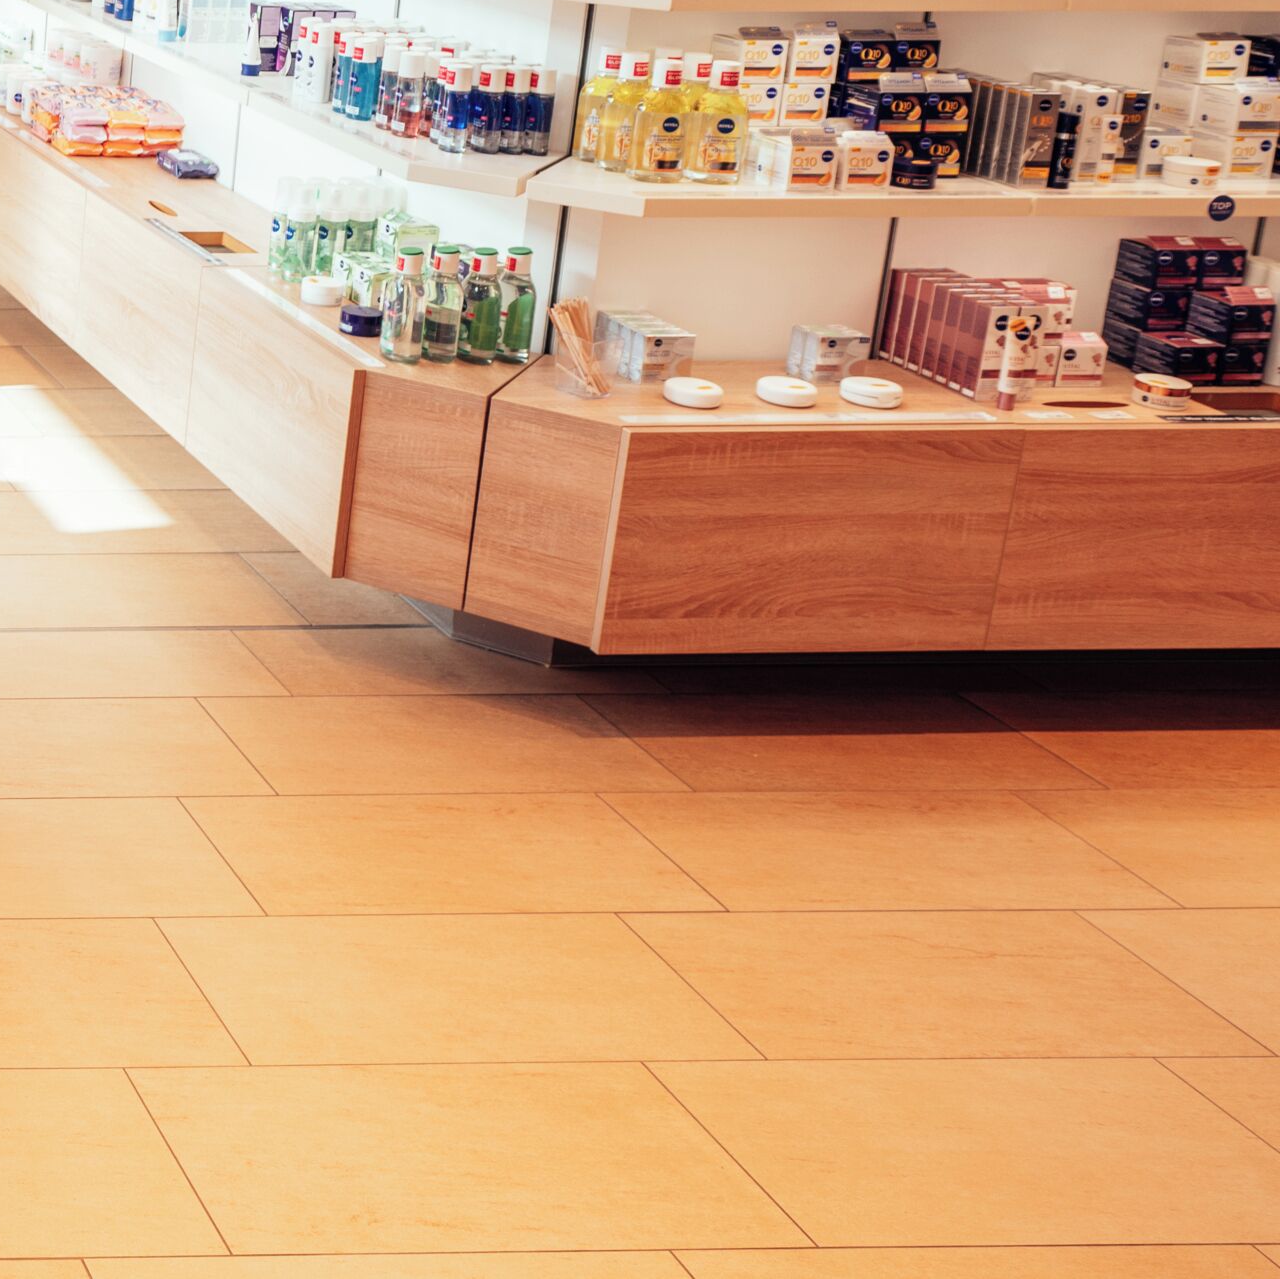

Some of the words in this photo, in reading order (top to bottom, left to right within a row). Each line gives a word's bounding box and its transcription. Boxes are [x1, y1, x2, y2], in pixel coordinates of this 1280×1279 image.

[861, 47, 882, 60] Q10
[907, 47, 927, 60] Q10
[891, 100, 912, 113] Q10
[938, 100, 959, 113] Q10
[930, 144, 951, 157] Q10
[793, 156, 817, 168] Q10
[849, 156, 873, 168] Q10
[1212, 201, 1232, 210] TOP
